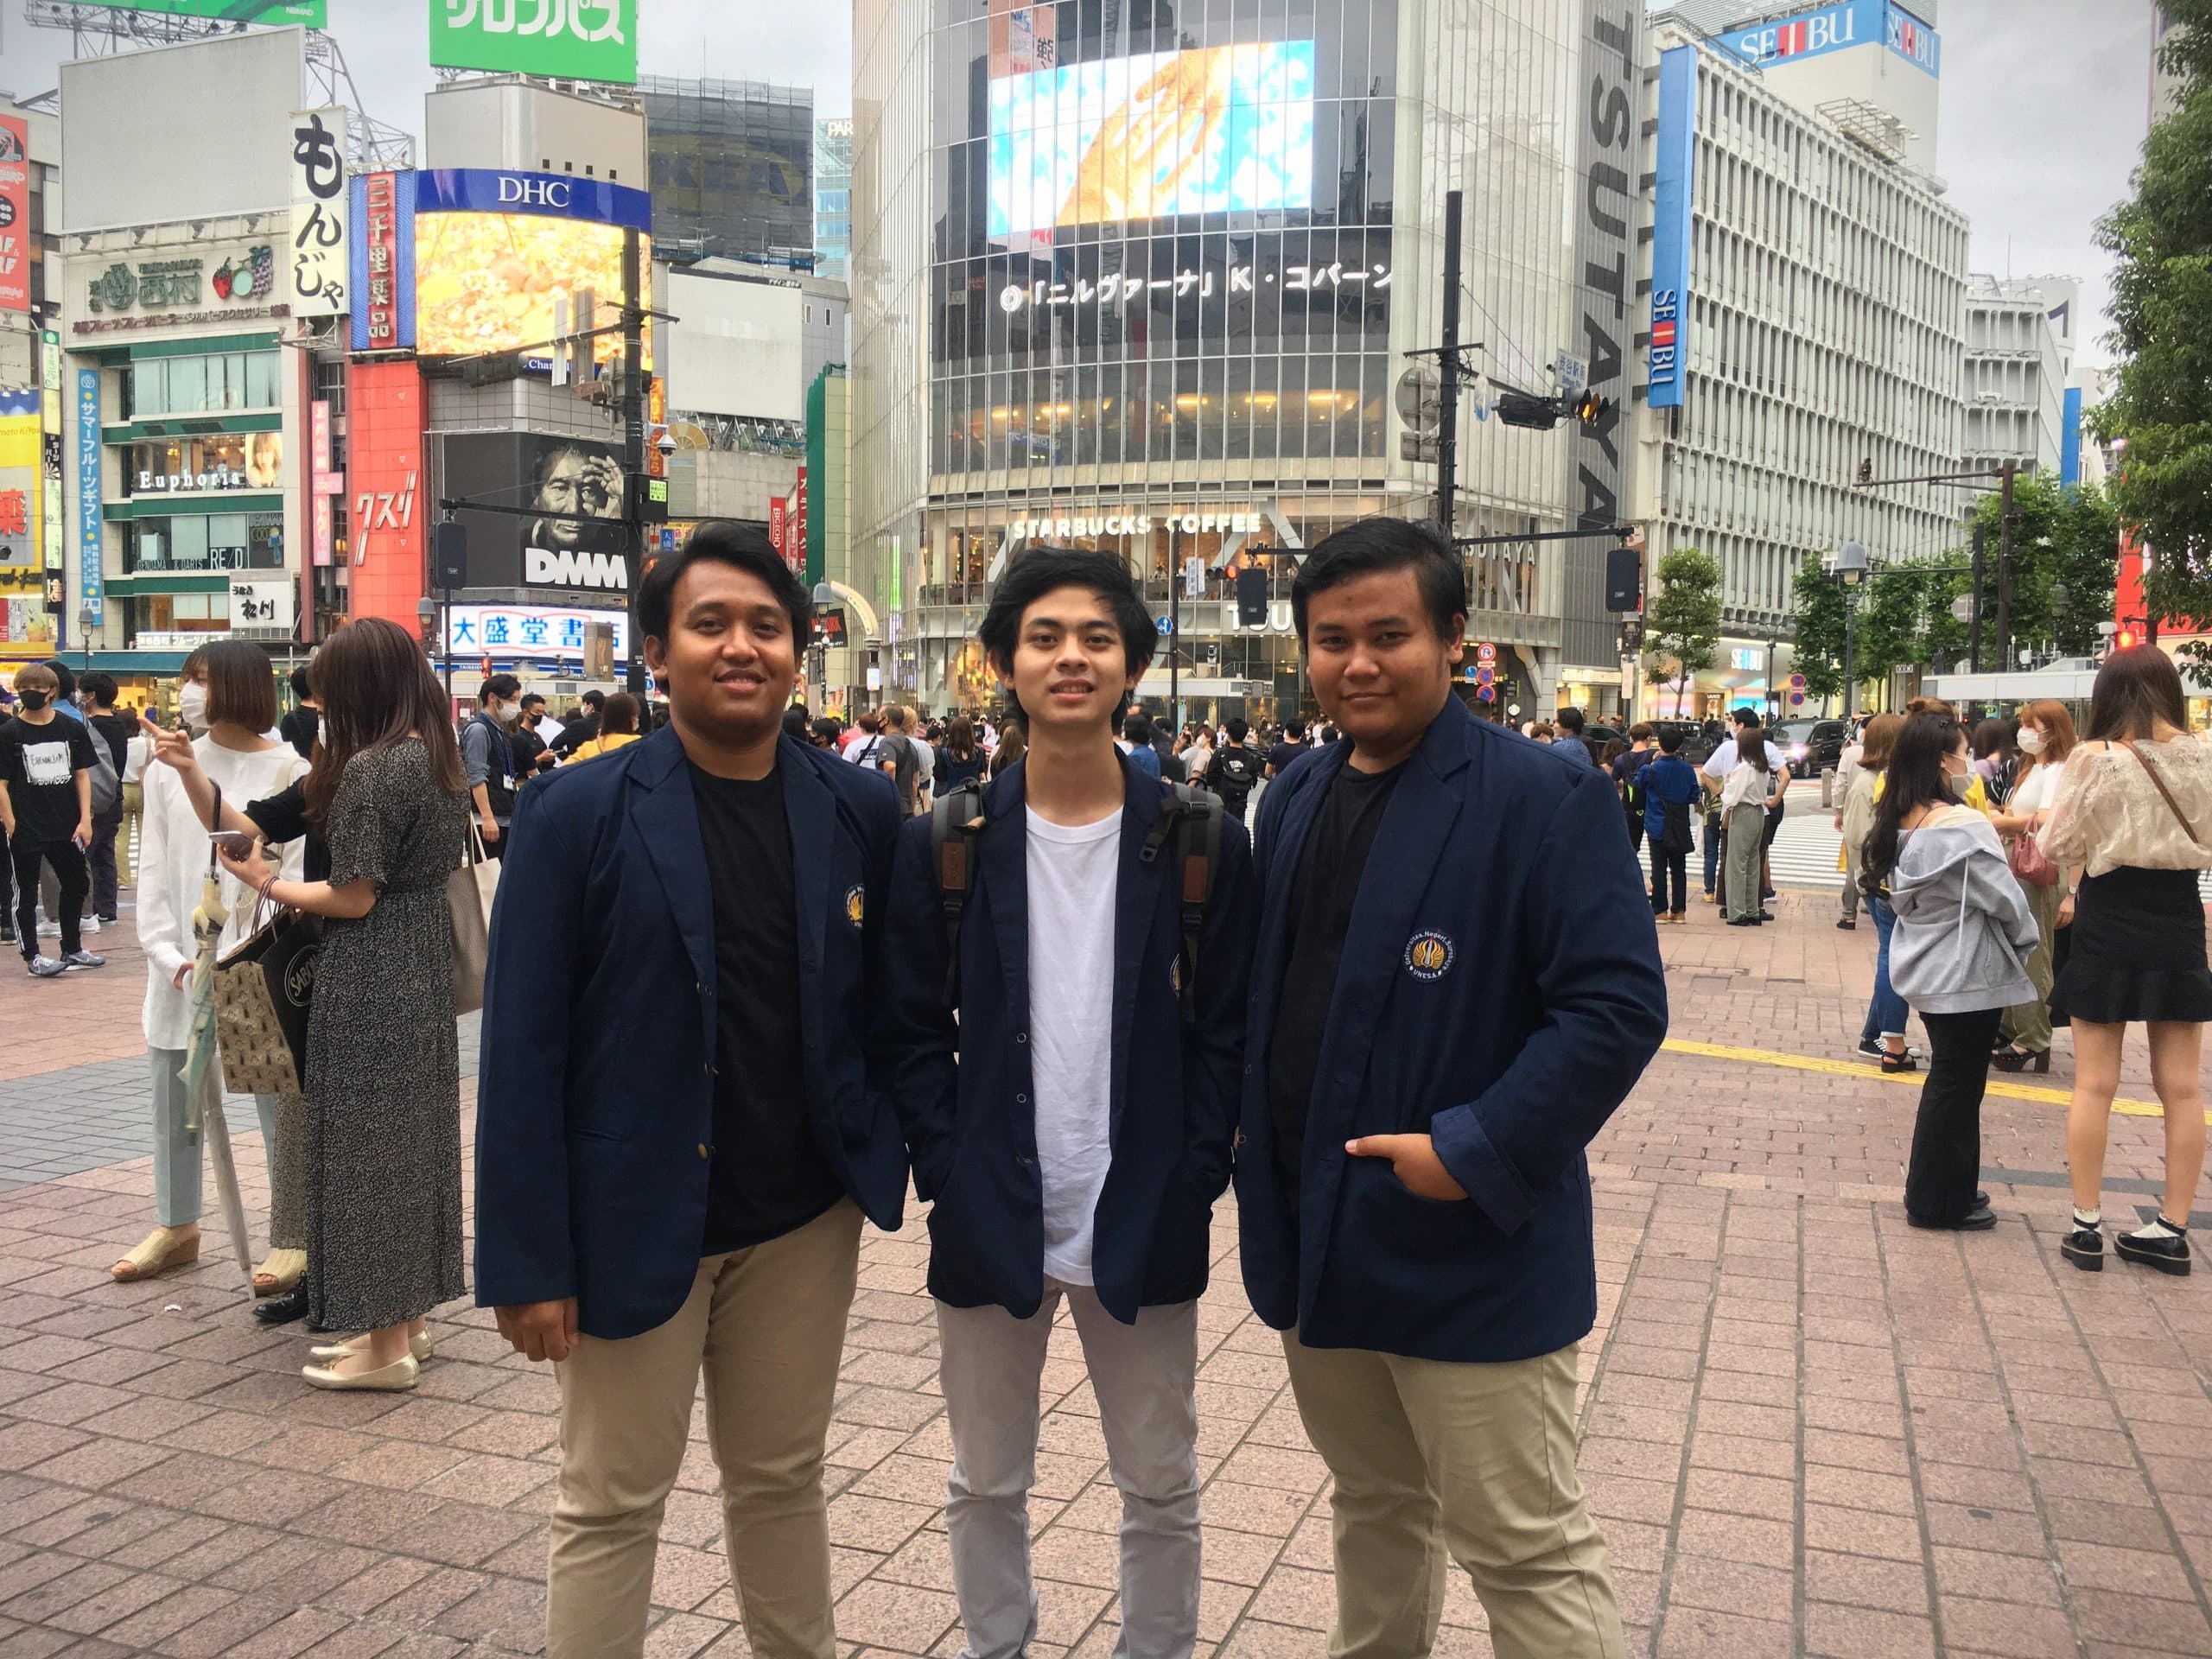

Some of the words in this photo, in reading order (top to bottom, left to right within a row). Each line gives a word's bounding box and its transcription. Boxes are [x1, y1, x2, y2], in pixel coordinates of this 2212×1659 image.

[1740, 7, 1856, 64] SEIBU
[1888, 10, 1935, 70] SEIBU
[294, 114, 343, 309] もんじゃ
[498, 177, 569, 207] DHC
[368, 179, 389, 338] 三千里薬品
[1578, 8, 1632, 531] TSUTAYA
[1650, 289, 1676, 385] SEIBU
[81, 403, 97, 529] サマーフルーツギフト
[139, 469, 241, 493] Euphoria
[1013, 515, 1152, 539] STARBUCKS
[1166, 513, 1261, 534] COFFEE
[211, 548, 243, 569] RE/D
[525, 548, 628, 589] DMM
[1413, 969, 1437, 979] UNESA
